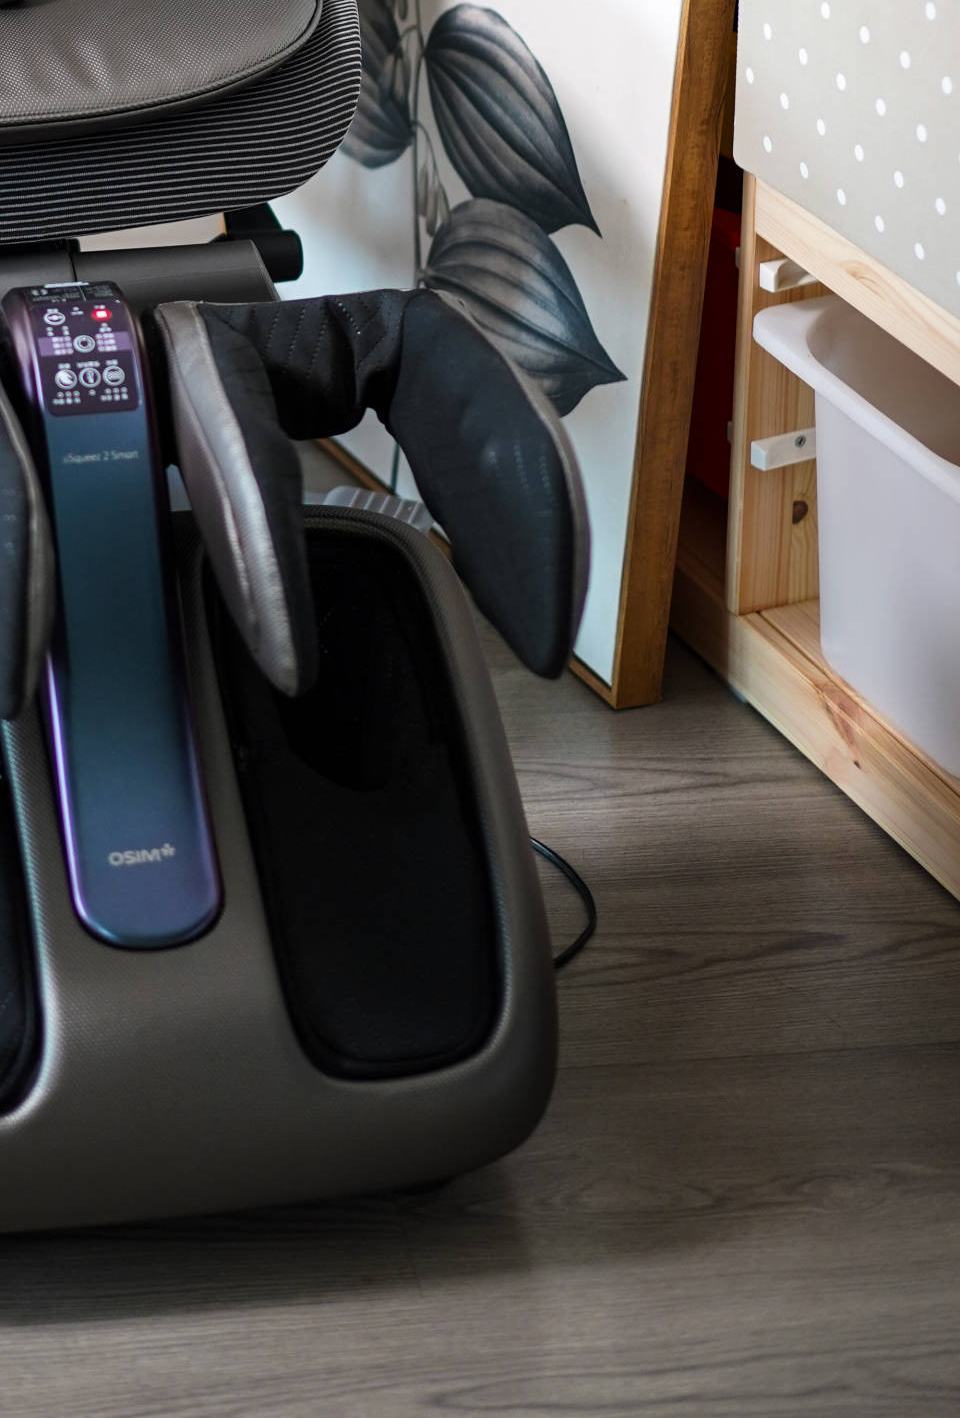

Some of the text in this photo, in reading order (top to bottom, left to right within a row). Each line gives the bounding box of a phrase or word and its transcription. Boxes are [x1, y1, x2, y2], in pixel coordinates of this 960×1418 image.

[103, 450, 109, 461] 2
[111, 449, 139, 461] Smart
[107, 848, 161, 866] OSIM
